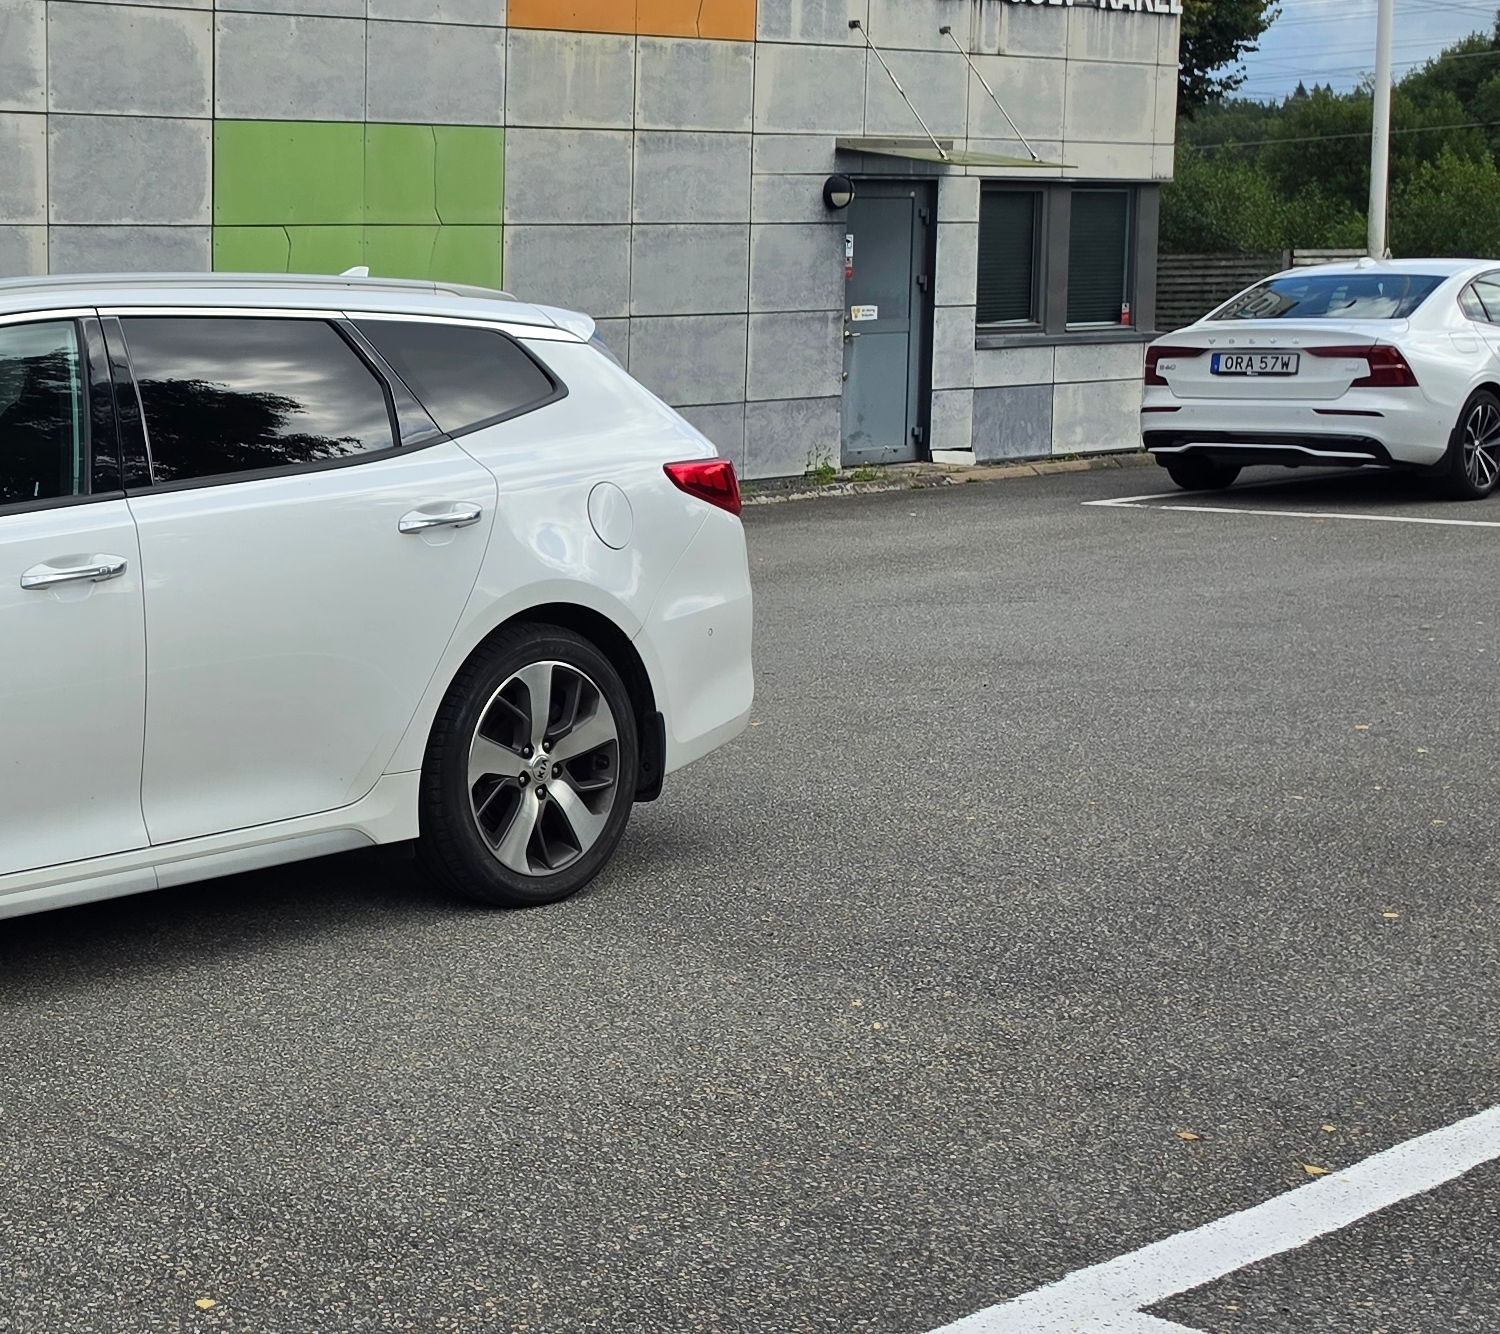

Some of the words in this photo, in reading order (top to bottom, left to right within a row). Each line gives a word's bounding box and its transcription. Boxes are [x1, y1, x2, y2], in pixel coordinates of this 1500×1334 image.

[1225, 356, 1253, 370] ORA
[1259, 356, 1291, 370] 57W
[537, 759, 549, 778] KIA
